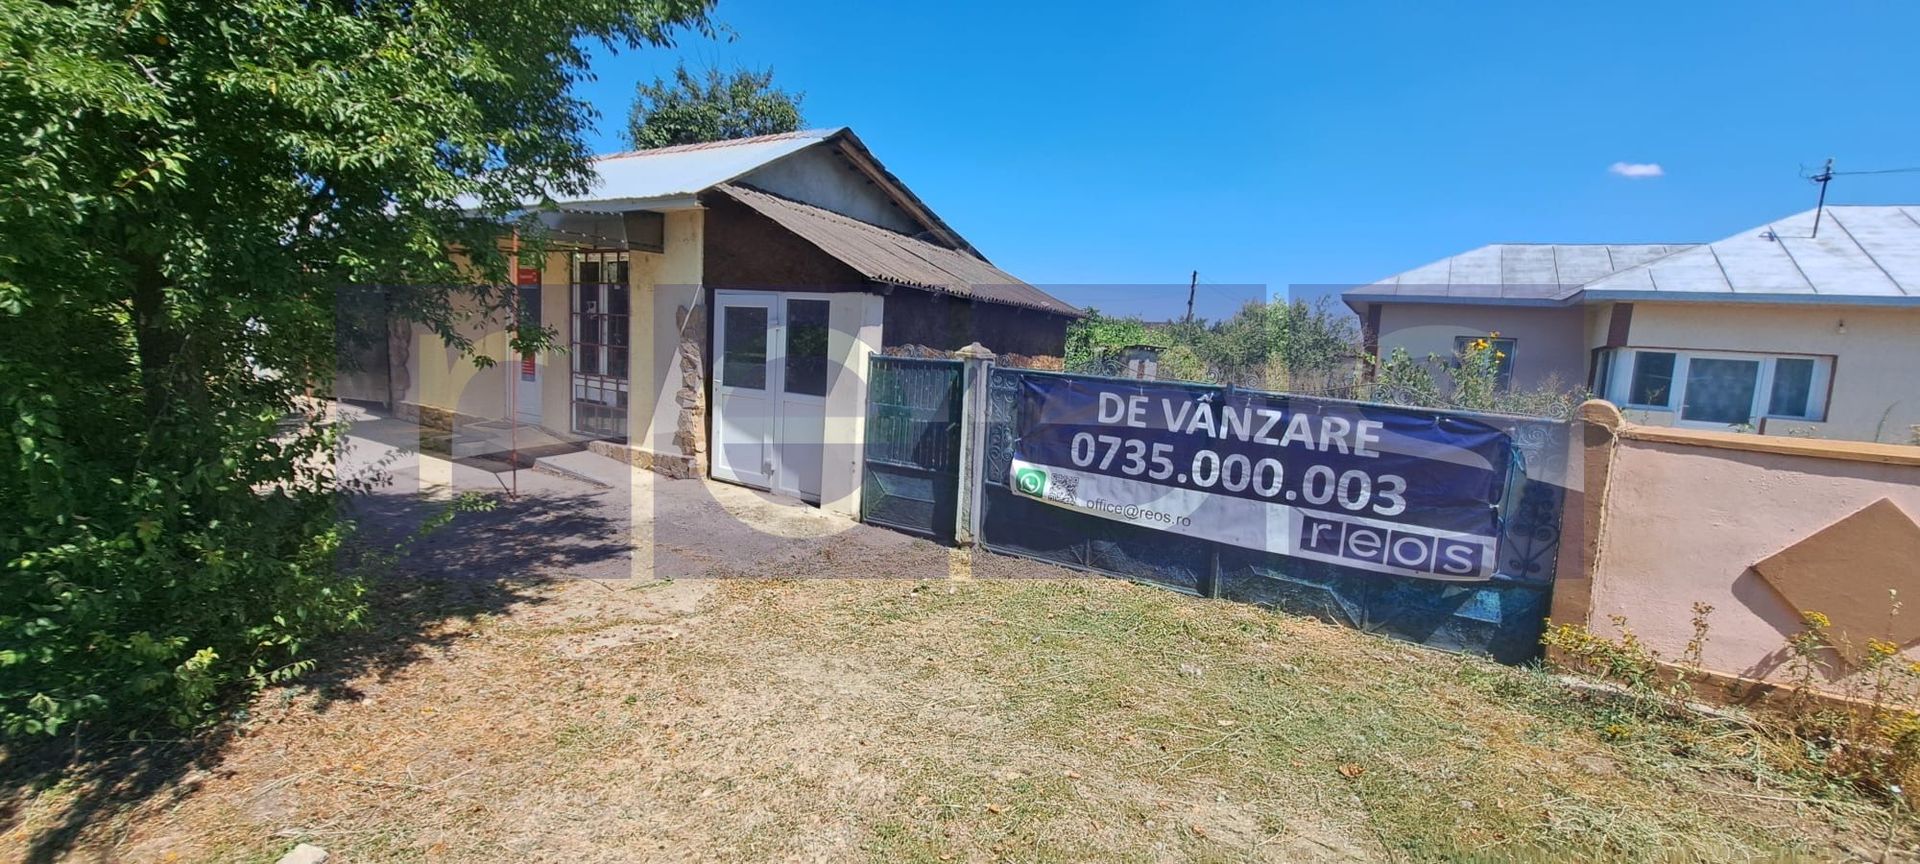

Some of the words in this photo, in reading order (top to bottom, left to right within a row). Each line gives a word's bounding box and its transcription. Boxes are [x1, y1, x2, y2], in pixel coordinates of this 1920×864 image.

[1098, 391, 1149, 428] DE
[1070, 432, 1408, 516] 0735.000.003
[1086, 498, 1192, 527] office@reos.ro
[1310, 521, 1474, 574] reos
